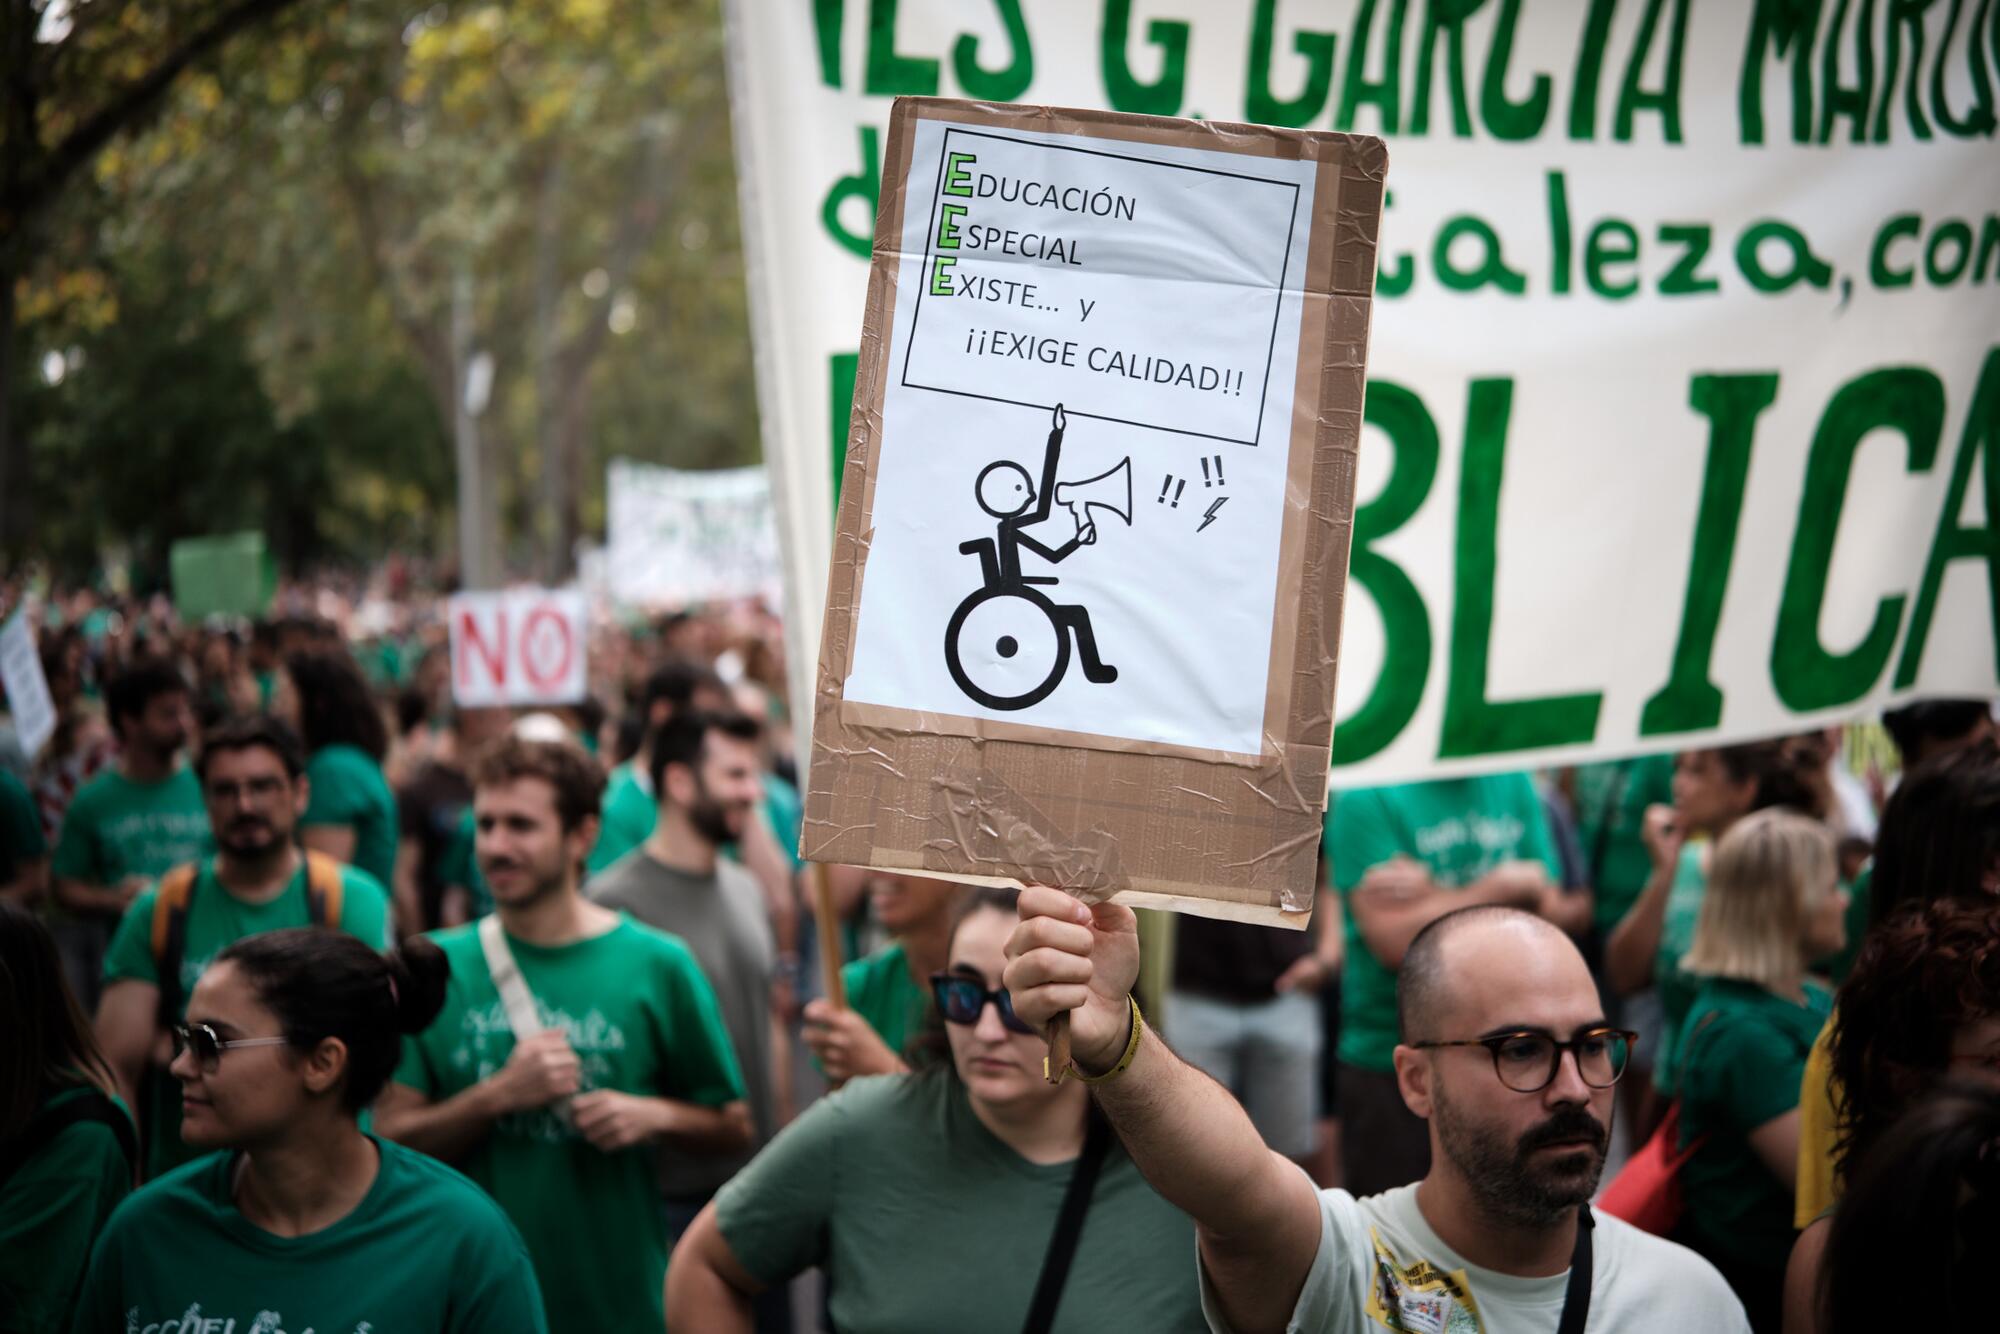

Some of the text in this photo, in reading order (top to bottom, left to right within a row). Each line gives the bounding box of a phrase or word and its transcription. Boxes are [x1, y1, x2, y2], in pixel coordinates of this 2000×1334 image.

[1737, 0, 2000, 146] MARQ
[942, 151, 1136, 221] EDUCACIÓN
[936, 203, 1083, 266] ESPECIAL
[929, 255, 1096, 322] EXISTE... y
[965, 328, 1245, 398] ¡¡EXIGE CALIDAD!!
[457, 603, 575, 695] NO
